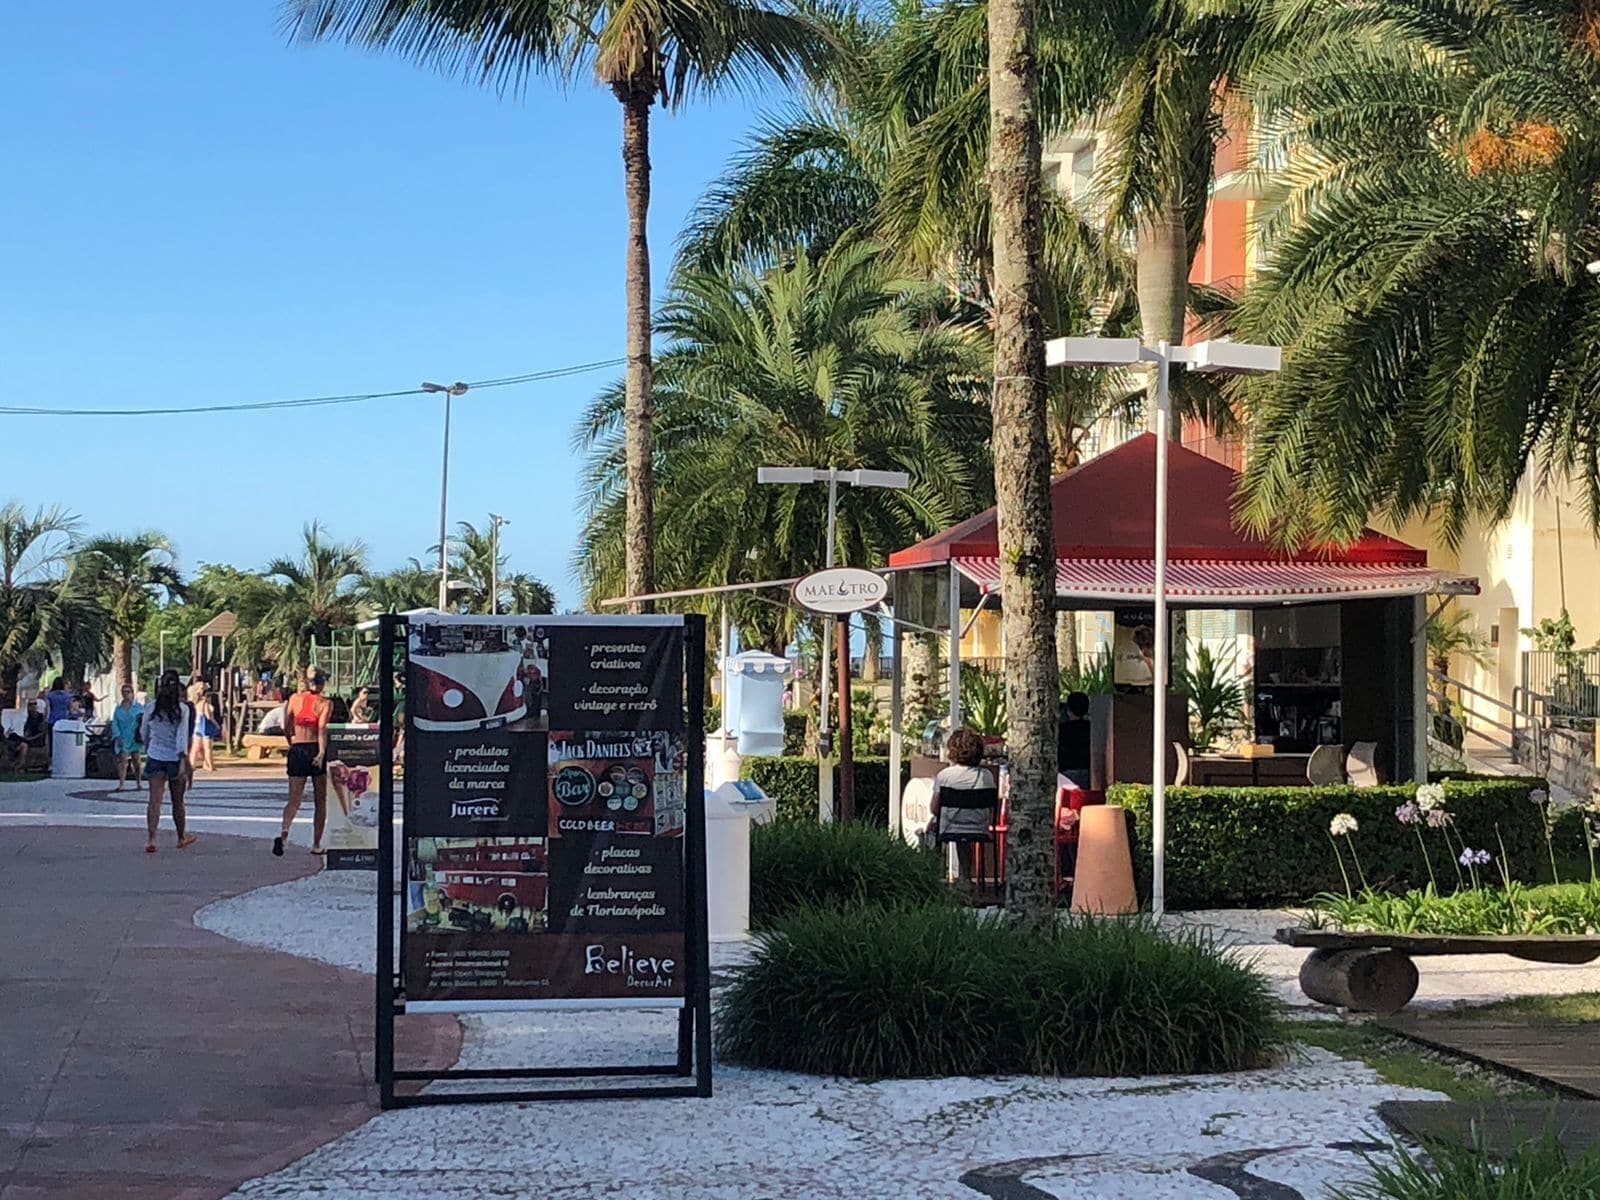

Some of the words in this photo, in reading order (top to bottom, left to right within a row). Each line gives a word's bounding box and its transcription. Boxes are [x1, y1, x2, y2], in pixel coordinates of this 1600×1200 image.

[591, 643, 646, 657] presentes
[590, 658, 641, 669] criativos
[588, 682, 648, 697] decoração
[574, 699, 618, 714] vintage
[619, 702, 626, 710] e
[628, 698, 657, 710] retrô
[454, 744, 509, 761] produtos
[560, 740, 584, 760] JACK
[444, 760, 510, 773] licenciados
[448, 777, 465, 789] da
[467, 780, 505, 789] marca
[559, 819, 585, 830] COLD
[586, 820, 615, 831] BEER
[601, 845, 640, 862] placas
[584, 862, 653, 874] decorativas
[586, 887, 656, 901] lembranças
[570, 904, 584, 916] de
[587, 903, 666, 920] Florianópolis
[585, 944, 675, 974] Believe
